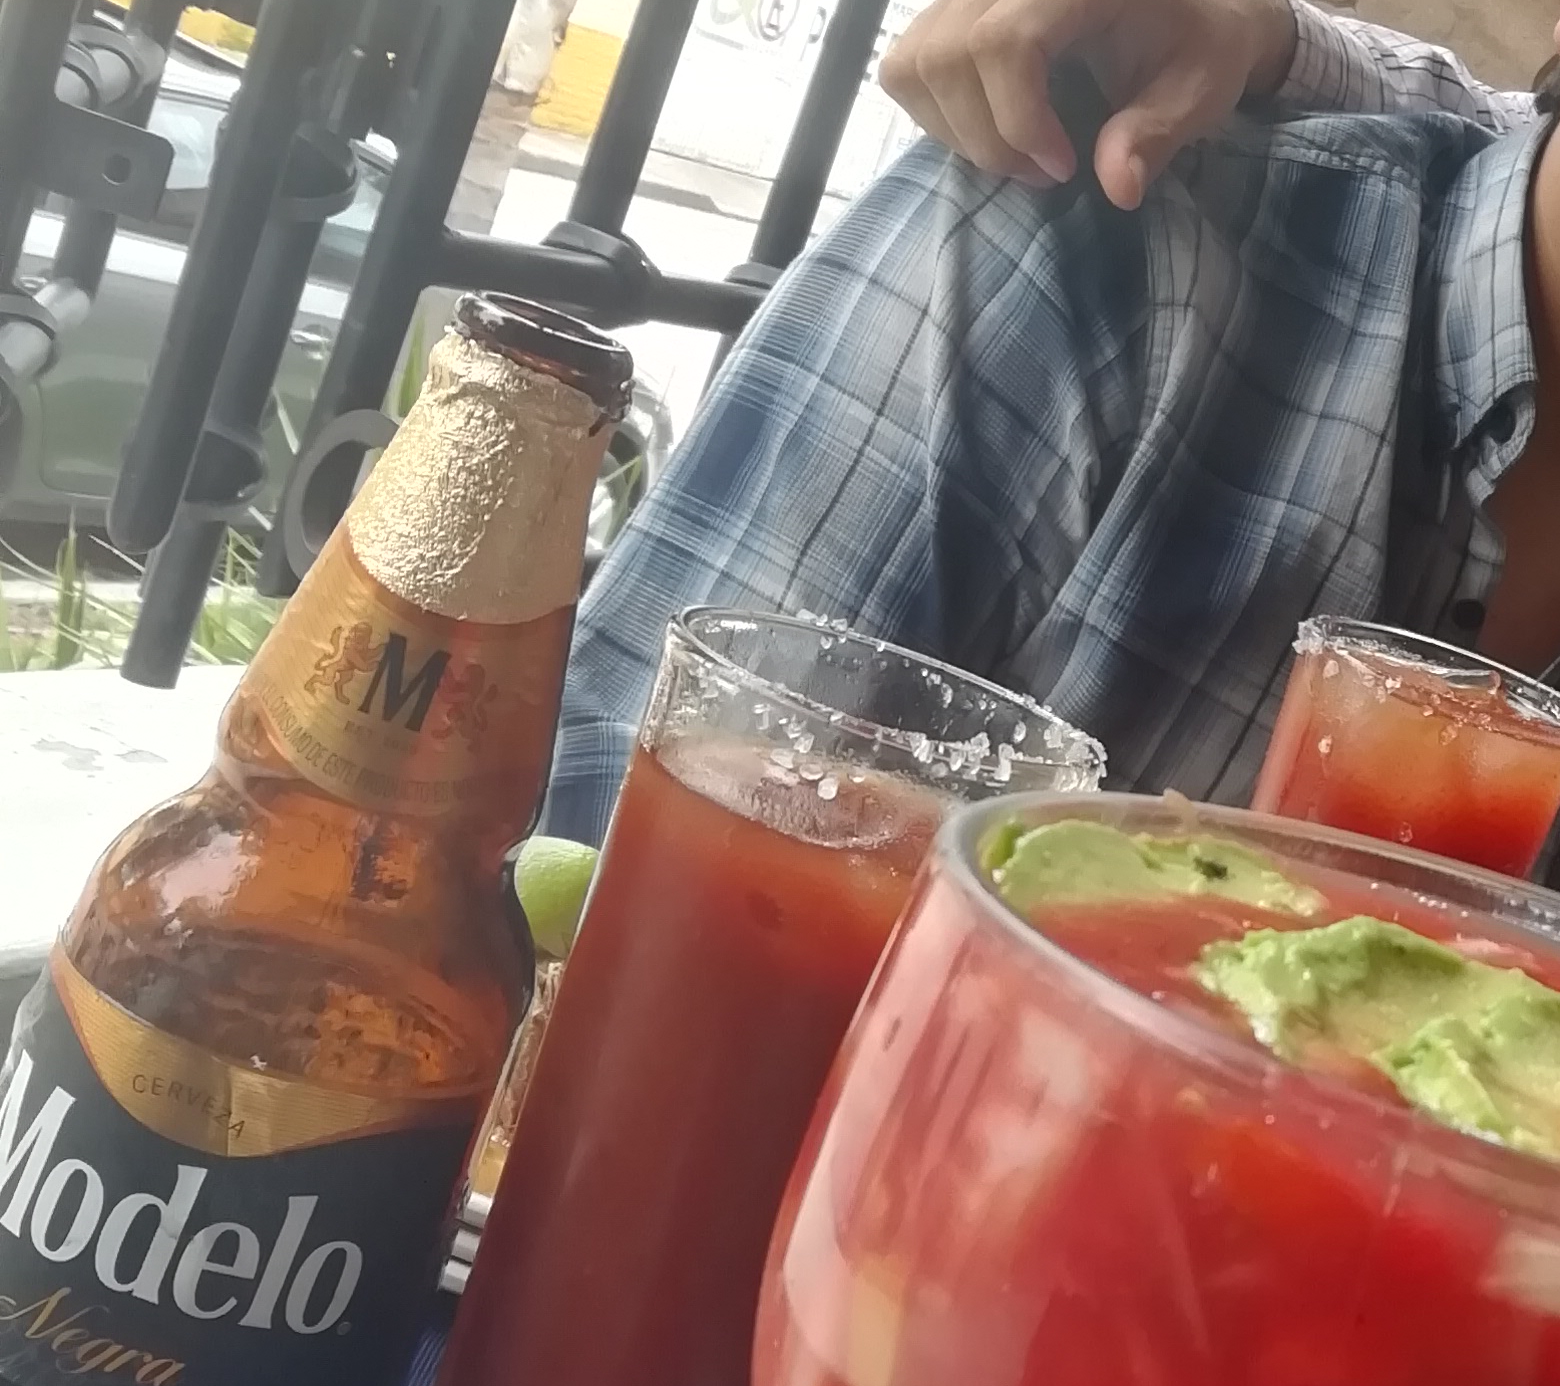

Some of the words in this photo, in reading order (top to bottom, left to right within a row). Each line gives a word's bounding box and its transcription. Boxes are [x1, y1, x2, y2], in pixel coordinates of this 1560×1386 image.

[357, 631, 453, 733] M
[306, 737, 330, 771] DE
[322, 750, 357, 785] ESTE
[131, 1072, 246, 1140] CERVEZA
